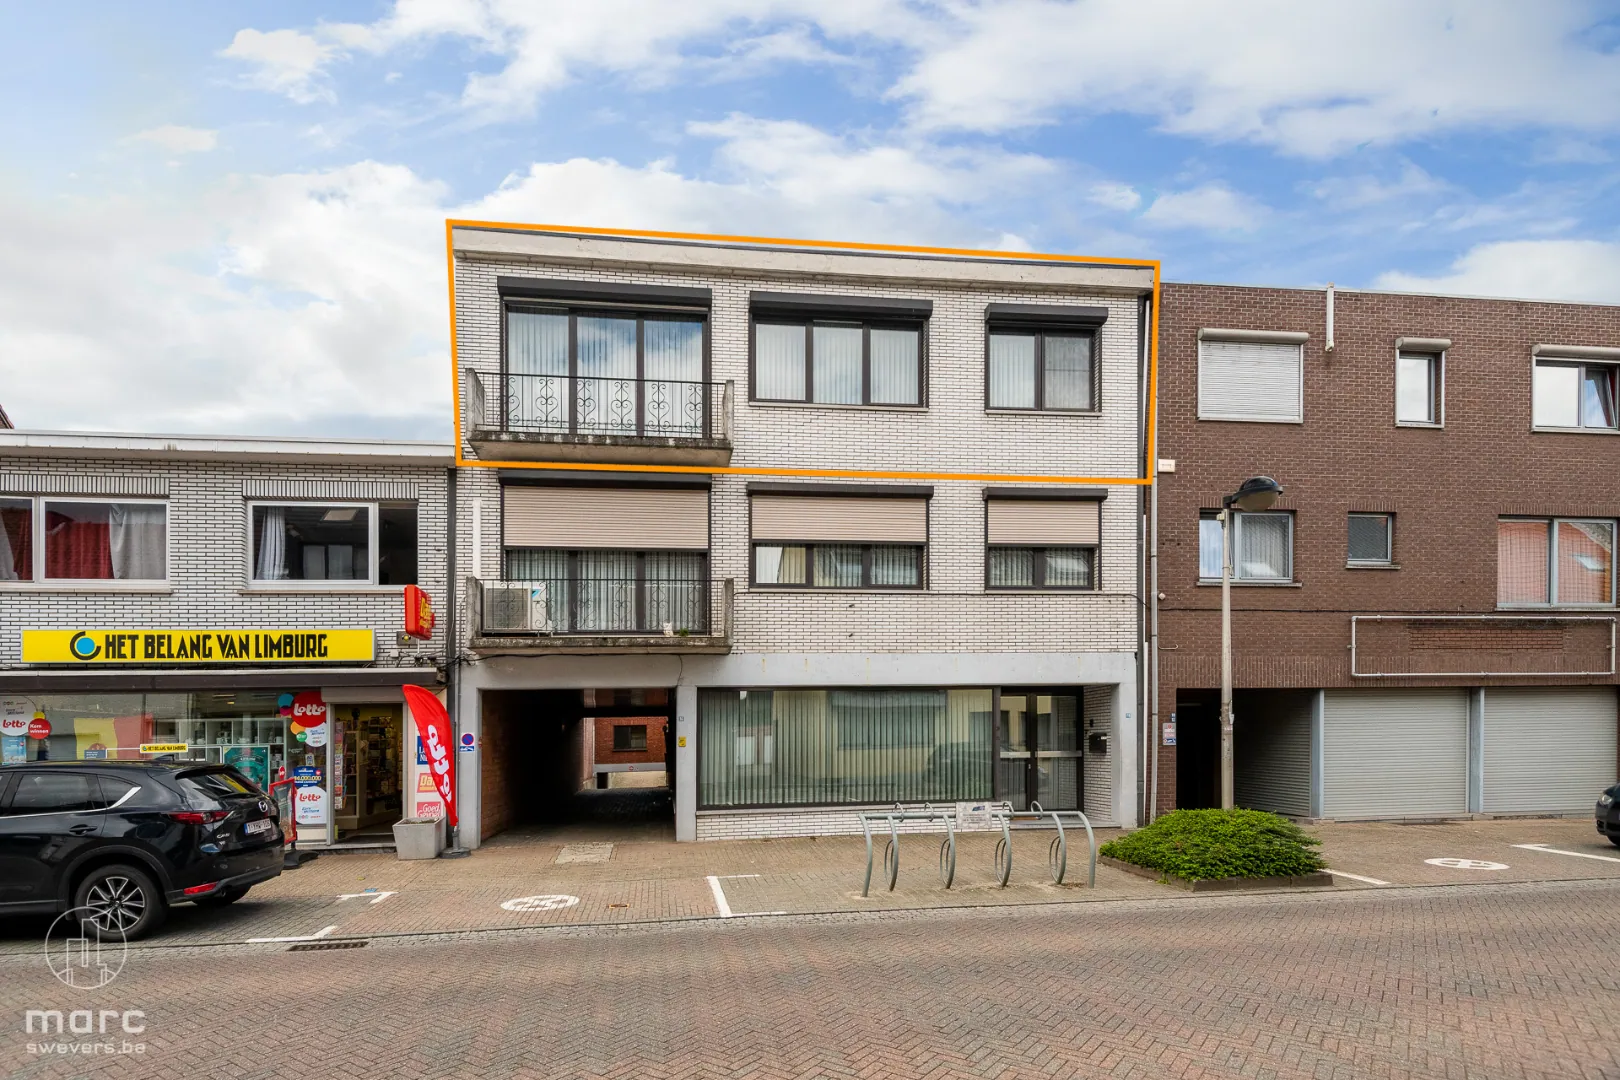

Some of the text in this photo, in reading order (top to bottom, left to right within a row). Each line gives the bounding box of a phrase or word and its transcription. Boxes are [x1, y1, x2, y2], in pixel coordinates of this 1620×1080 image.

[105, 634, 328, 659] HET BELANG VAN LIMBURG
[293, 704, 326, 716] Lotto
[3, 719, 26, 728] Lotto
[299, 793, 321, 802] Lotto
